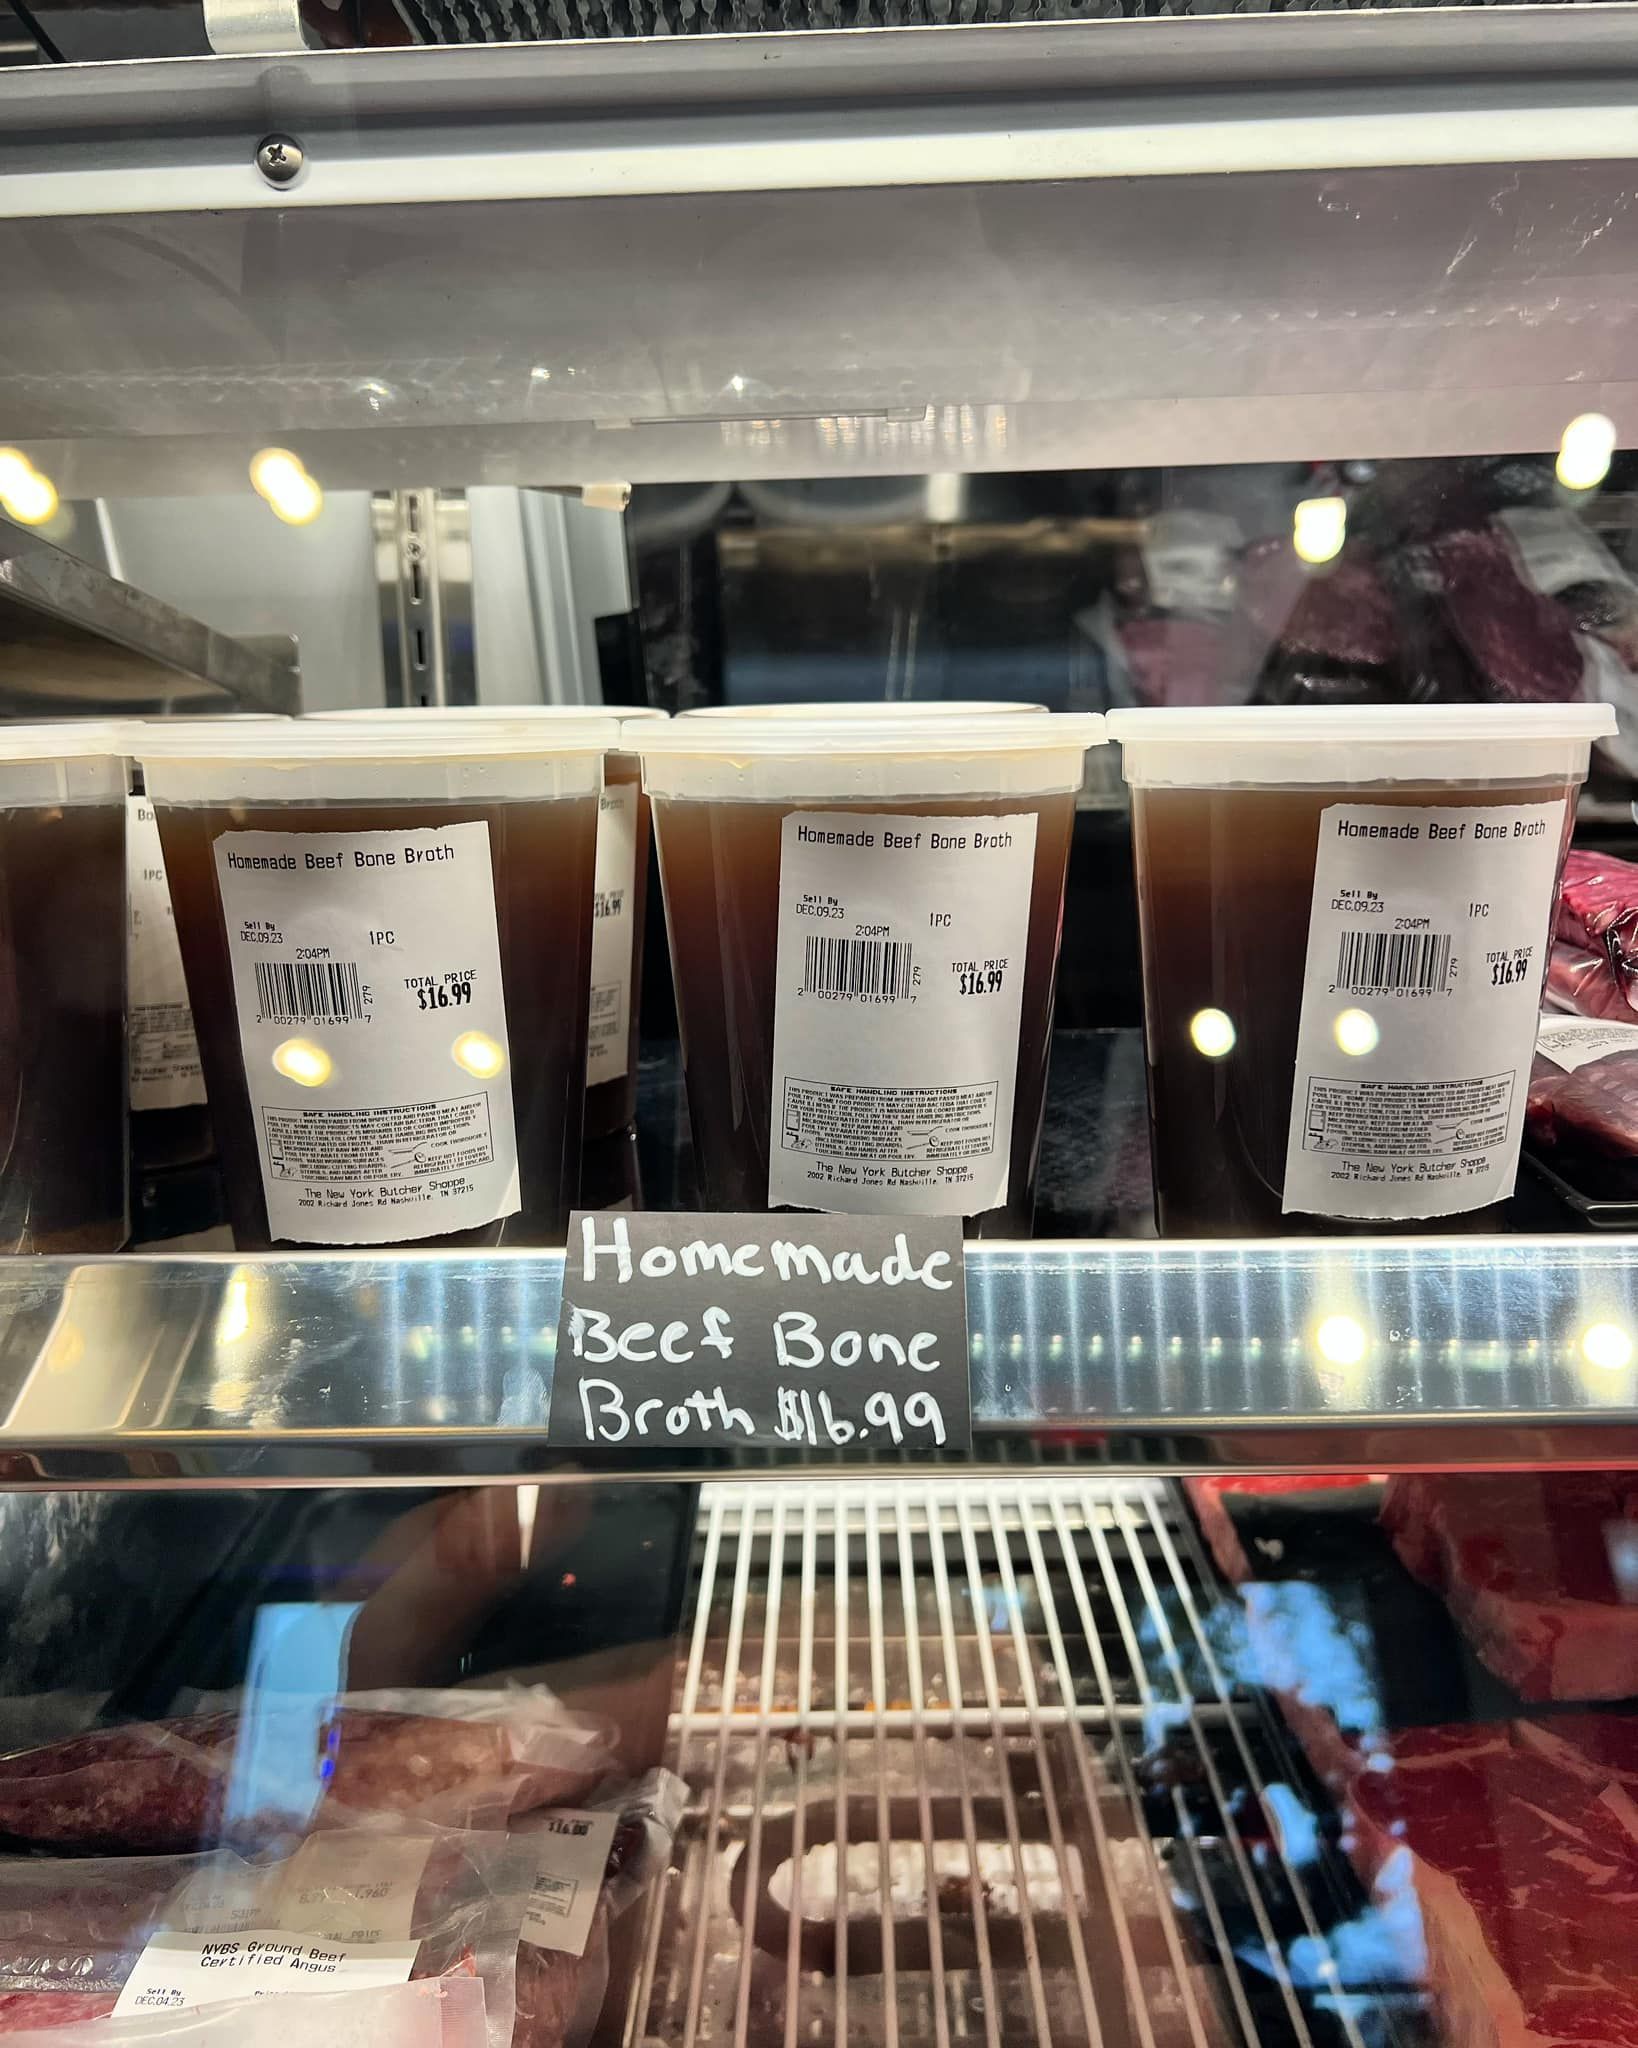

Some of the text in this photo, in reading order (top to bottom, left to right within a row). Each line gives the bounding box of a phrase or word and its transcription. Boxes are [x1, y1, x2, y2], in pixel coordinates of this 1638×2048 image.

[1338, 819, 1546, 839] Homemade Beef Bone Broth
[798, 826, 1012, 849] Homemade Beef Bone Broth
[228, 844, 455, 870] Homemade Beef Bone Broth
[803, 894, 838, 906] Sell By
[1340, 889, 1378, 900] Sell By
[796, 904, 844, 919] DEC.09.23
[1469, 903, 1489, 918] 1PC
[244, 921, 276, 932] Sell By
[930, 912, 951, 927] 1PC
[369, 930, 395, 945] 1PC
[855, 925, 890, 937] 2:04PM
[296, 947, 330, 960] 2:04PM
[1486, 946, 1533, 963] TOTAL PRICE
[951, 958, 1008, 973] TOTAL PRICE
[1491, 959, 1527, 986] $16.99
[404, 969, 478, 990] TOTAL PRICE
[912, 966, 921, 985] 279
[959, 971, 1003, 996] $16.99
[417, 981, 472, 1010] $16.99
[797, 988, 917, 1004] 2 00279 01699 7
[1328, 985, 1452, 997] 2 00279 01699 7
[256, 1014, 371, 1026] 2 00279 01699 7
[816, 1161, 968, 1177] The New York Butcher Shoppe
[1342, 1161, 1361, 1172] The
[1366, 1162, 1384, 1173] New
[1391, 1163, 1414, 1173] York
[1419, 1162, 1456, 1173] Butcher
[807, 1171, 824, 1180] 2002
[828, 1174, 857, 1184] Richard
[887, 1178, 896, 1186] Rd
[1354, 1173, 1386, 1182] Richard
[305, 1177, 465, 1199] The New York Butcher Shoppe
[299, 1199, 314, 1207] 2002
[318, 1200, 347, 1208] Richard
[351, 1200, 373, 1208] Jones
[581, 1216, 953, 1290] Homemade
[568, 1306, 942, 1372] Beef Bone
[579, 1376, 947, 1446] Broth $16.99
[202, 1941, 347, 1962] NYBS Ground Beef
[200, 1953, 337, 1973] Certified Angus
